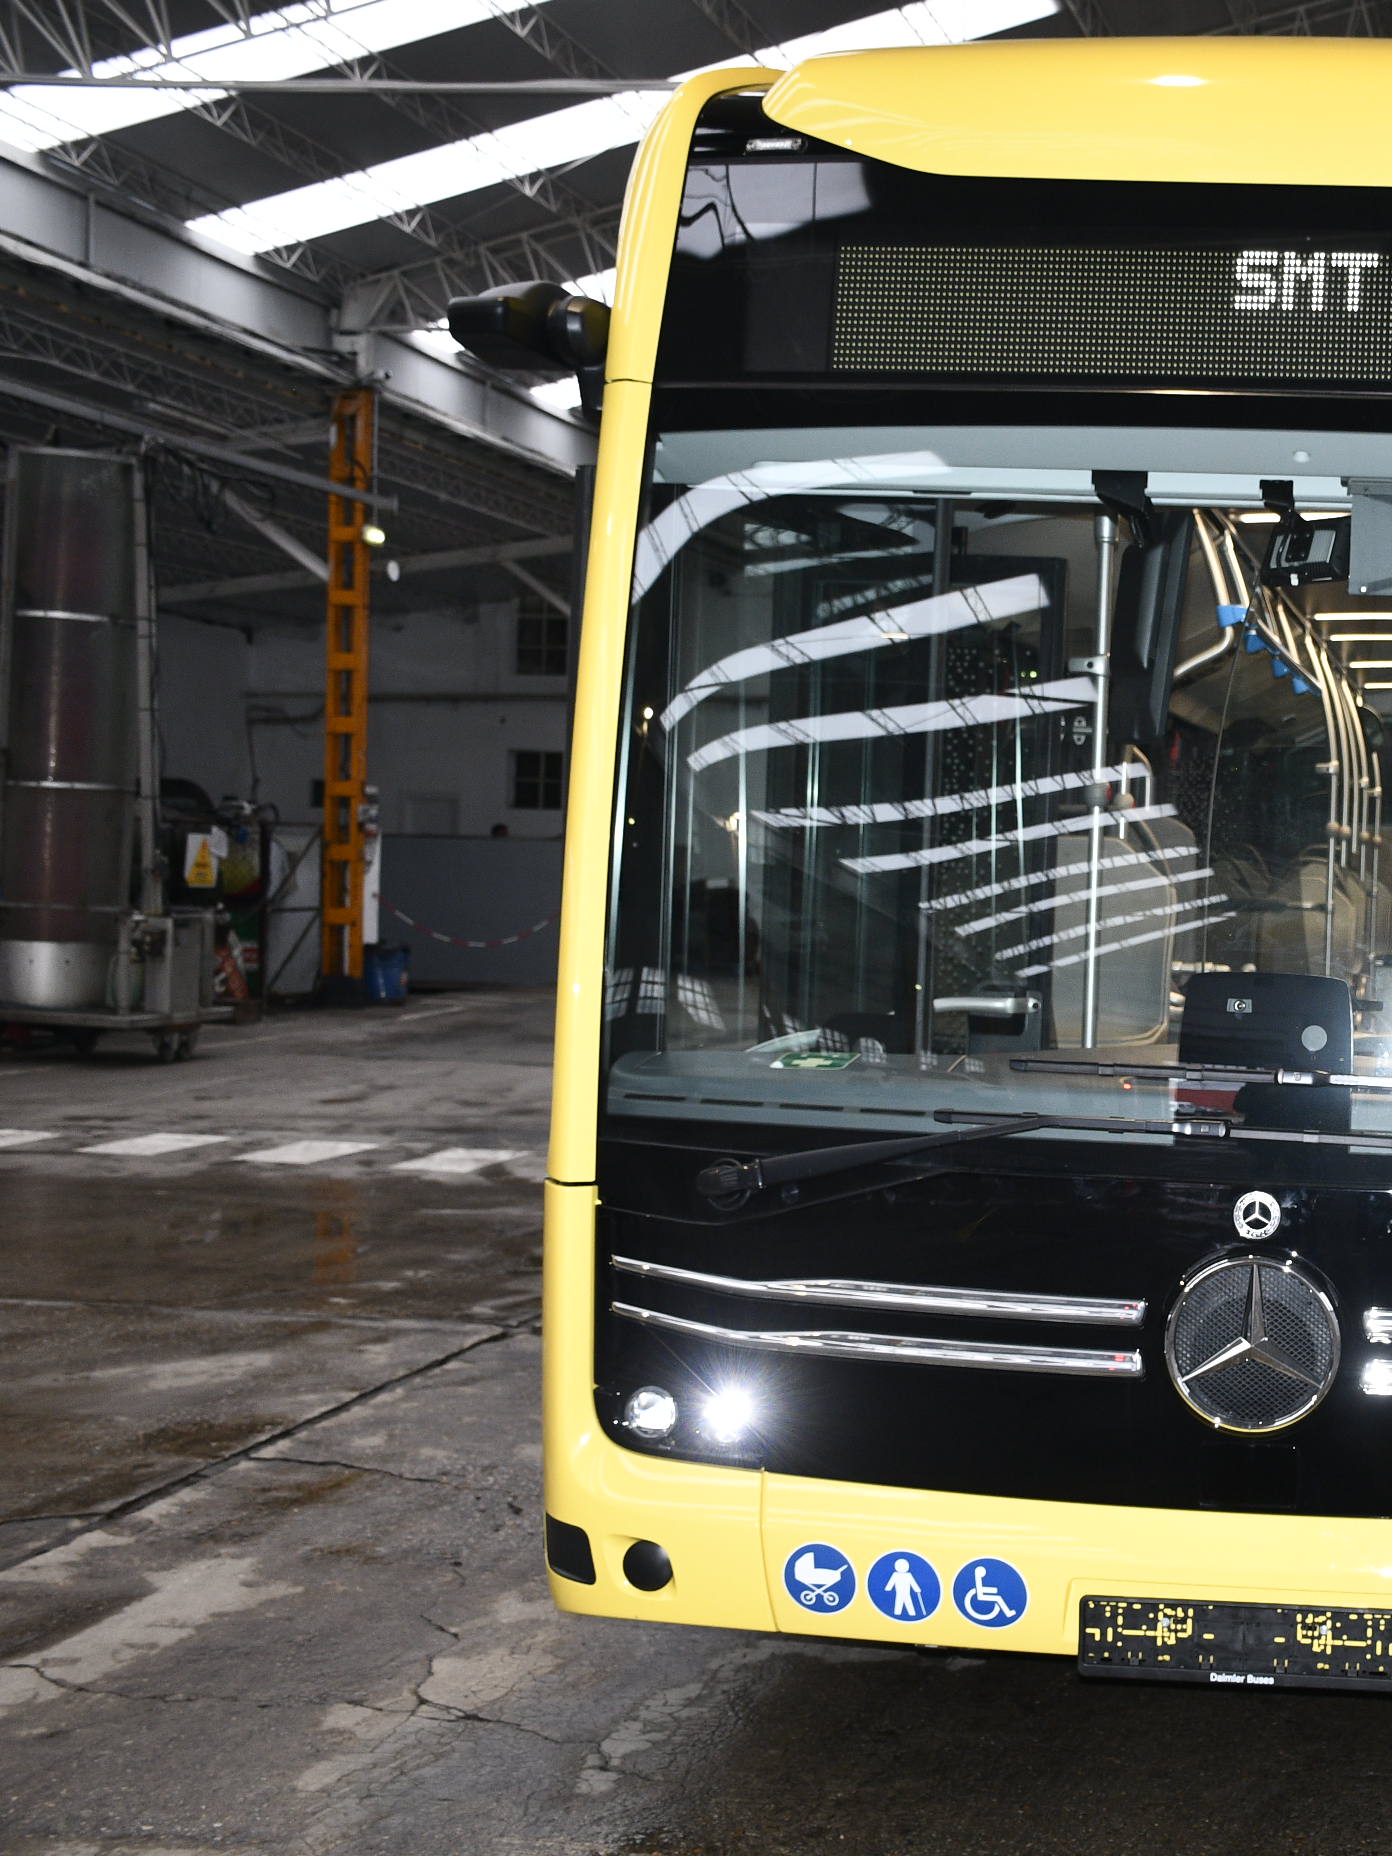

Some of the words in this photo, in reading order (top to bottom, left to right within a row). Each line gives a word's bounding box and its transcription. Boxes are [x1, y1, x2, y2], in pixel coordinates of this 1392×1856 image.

[1233, 250, 1379, 312] SMT
[1209, 1671, 1246, 1684] Daimler
[1246, 1674, 1275, 1685] Buses
